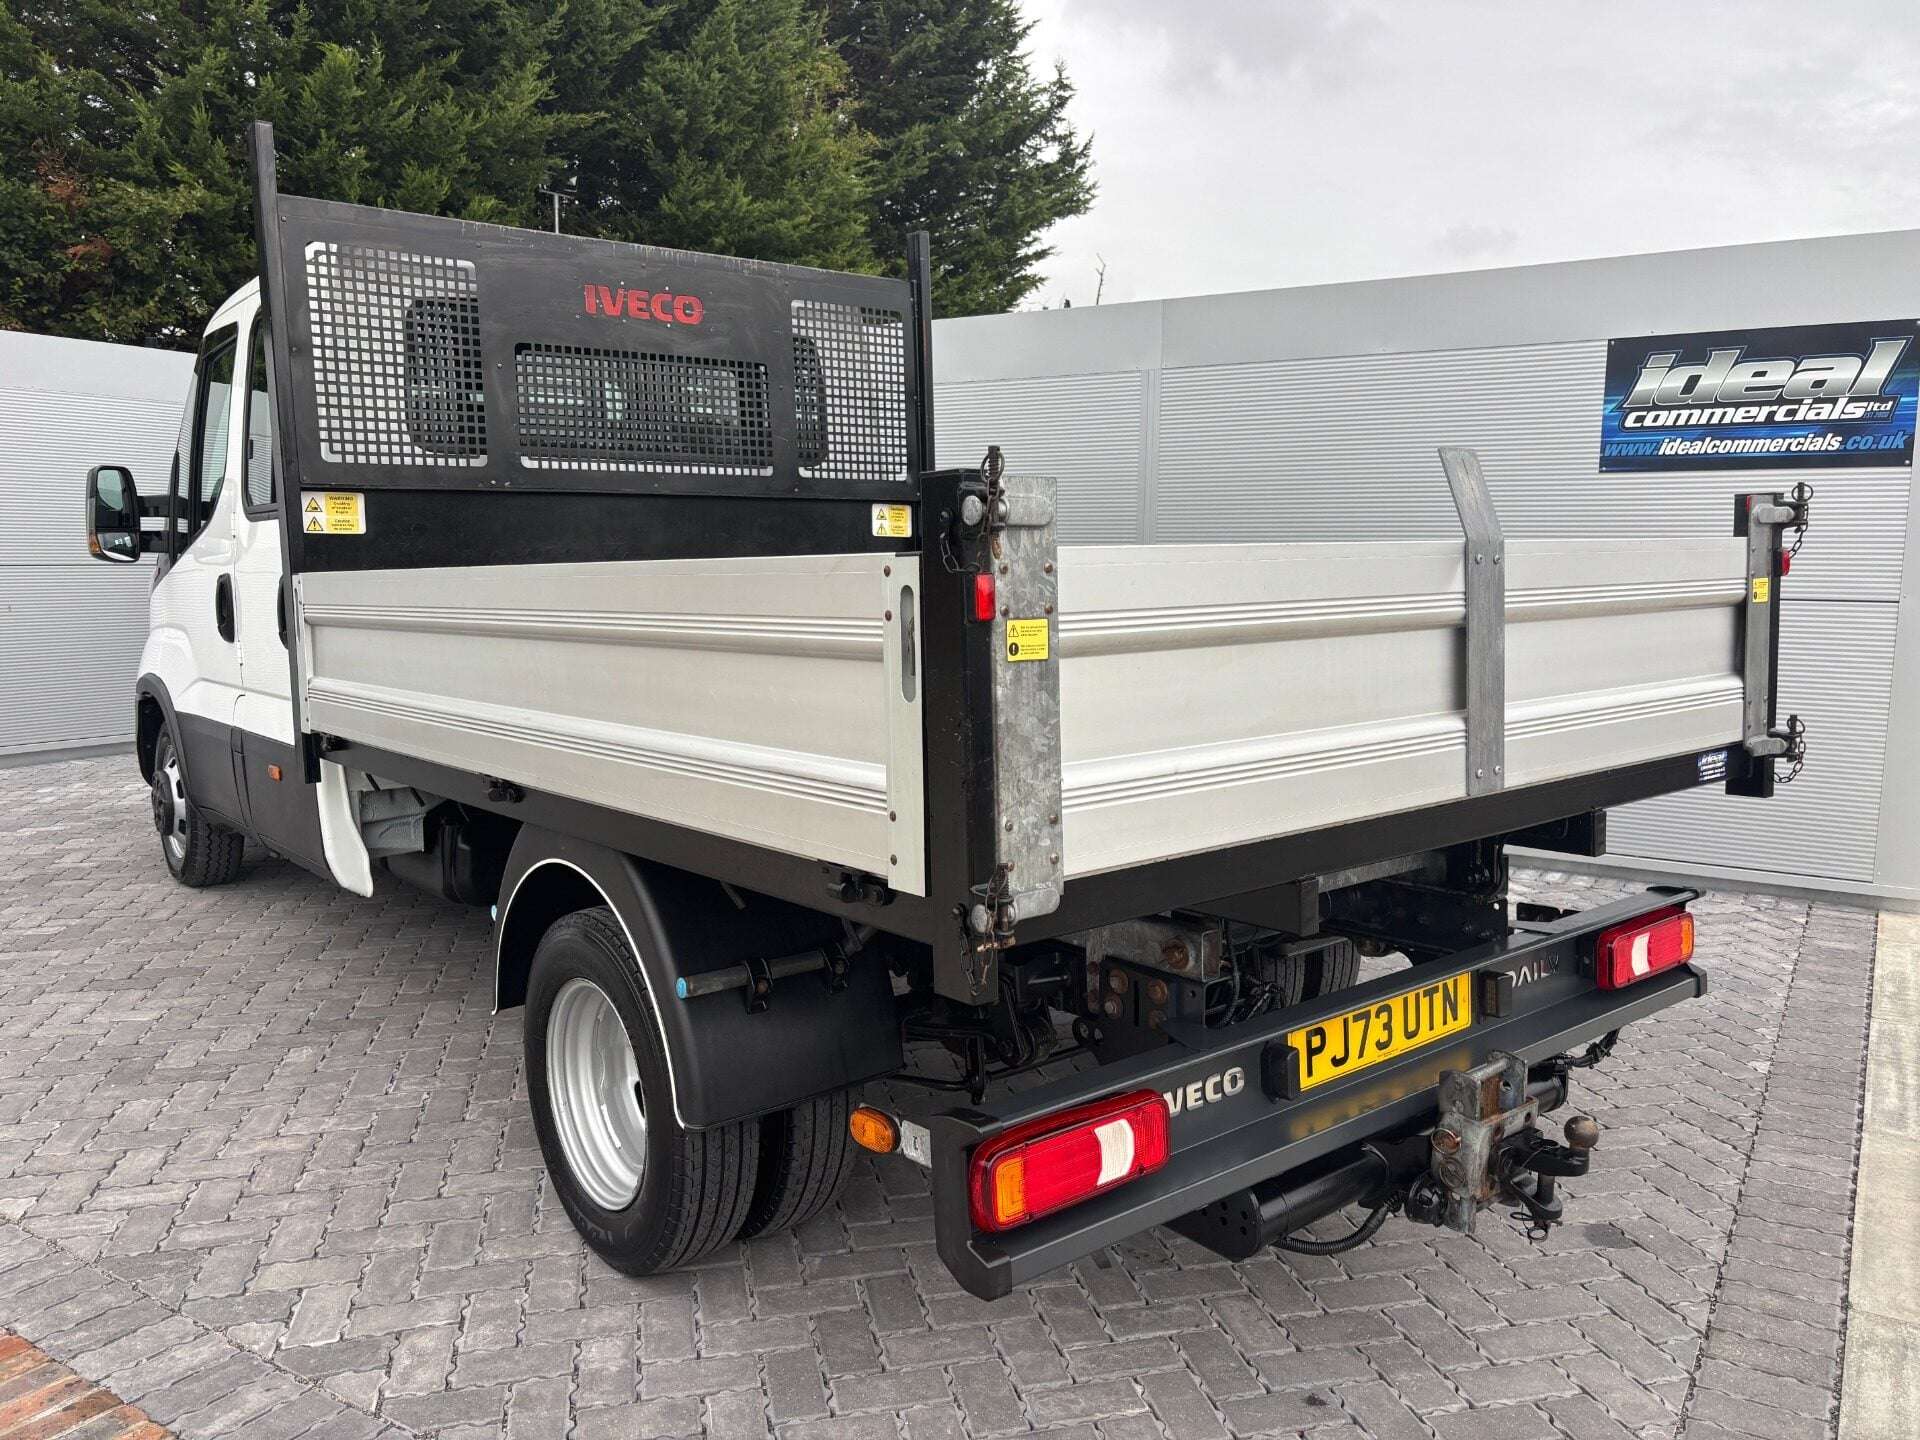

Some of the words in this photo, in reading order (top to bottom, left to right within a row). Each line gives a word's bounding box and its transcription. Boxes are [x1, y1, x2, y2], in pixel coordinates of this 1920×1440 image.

[584, 284, 704, 325] IVECO
[1623, 339, 1907, 407] ideal
[1624, 397, 1867, 428] commercials
[1865, 400, 1893, 412] ltd
[1604, 431, 1908, 457] www.idealcommercials.co.uk
[1306, 1003, 1393, 1078] PJ73
[1403, 978, 1458, 1041] UTN
[1162, 1066, 1245, 1118] VECO
